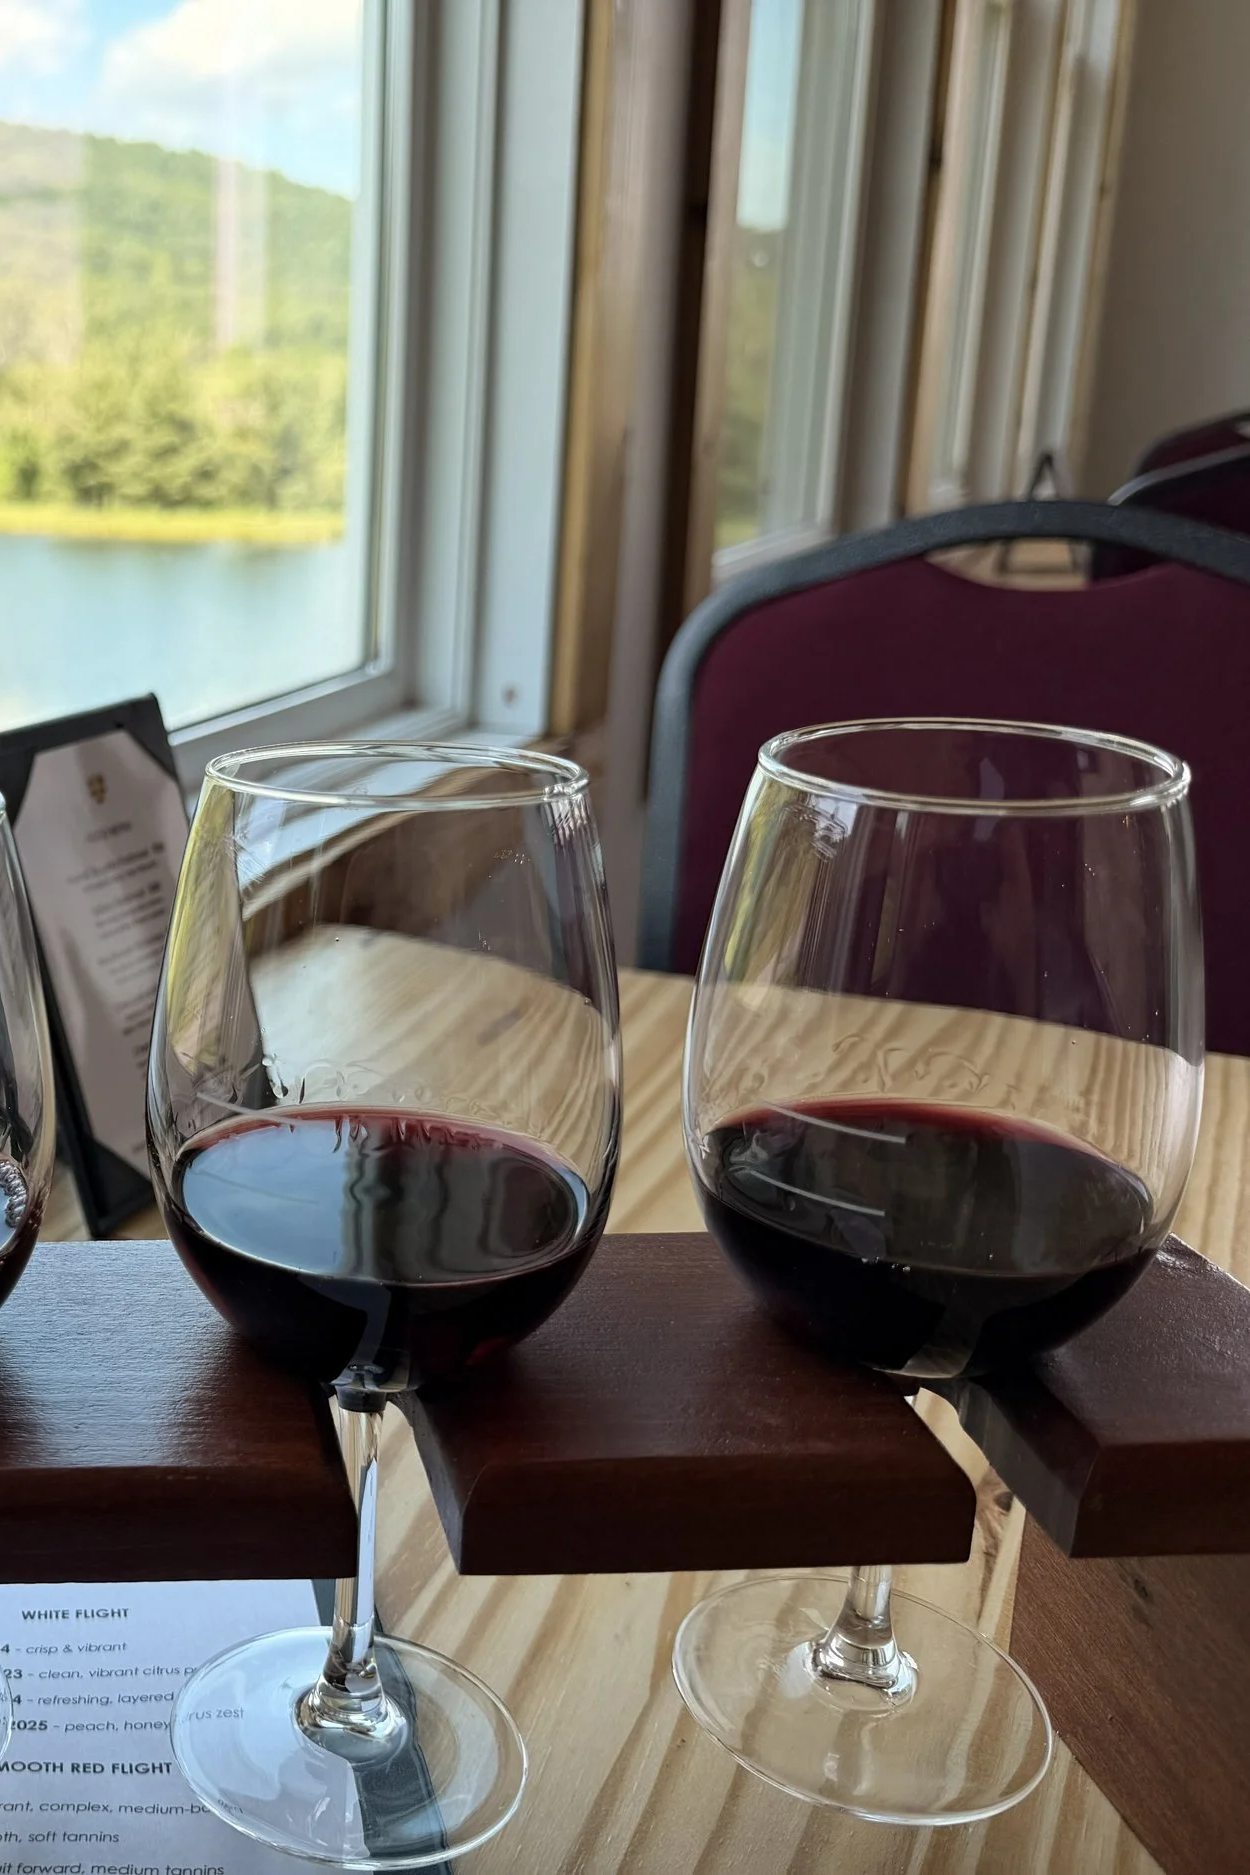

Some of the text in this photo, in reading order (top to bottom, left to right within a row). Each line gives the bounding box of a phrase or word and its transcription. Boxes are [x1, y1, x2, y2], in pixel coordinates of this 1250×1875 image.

[22, 1608, 130, 1620] WHITE FLIGHT
[26, 1645, 58, 1655] crisp
[63, 1643, 73, 1653] &
[77, 1641, 127, 1652] vibrant
[39, 1669, 83, 1680] clean,
[89, 1665, 138, 1677] vibrant
[143, 1664, 180, 1675] citrus
[38, 1694, 113, 1707] refreshing,
[118, 1692, 174, 1704] layered
[64, 1720, 119, 1732] peach,
[216, 1706, 245, 1718] zest
[70, 1763, 105, 1774] RED
[111, 1762, 172, 1774] FLIGHT
[39, 1802, 113, 1814] complex,
[28, 1831, 56, 1843] soft
[62, 1831, 120, 1843] tannins
[16, 1862, 85, 1875] forward,
[90, 1863, 160, 1875] medium
[166, 1865, 224, 1875] tannins
